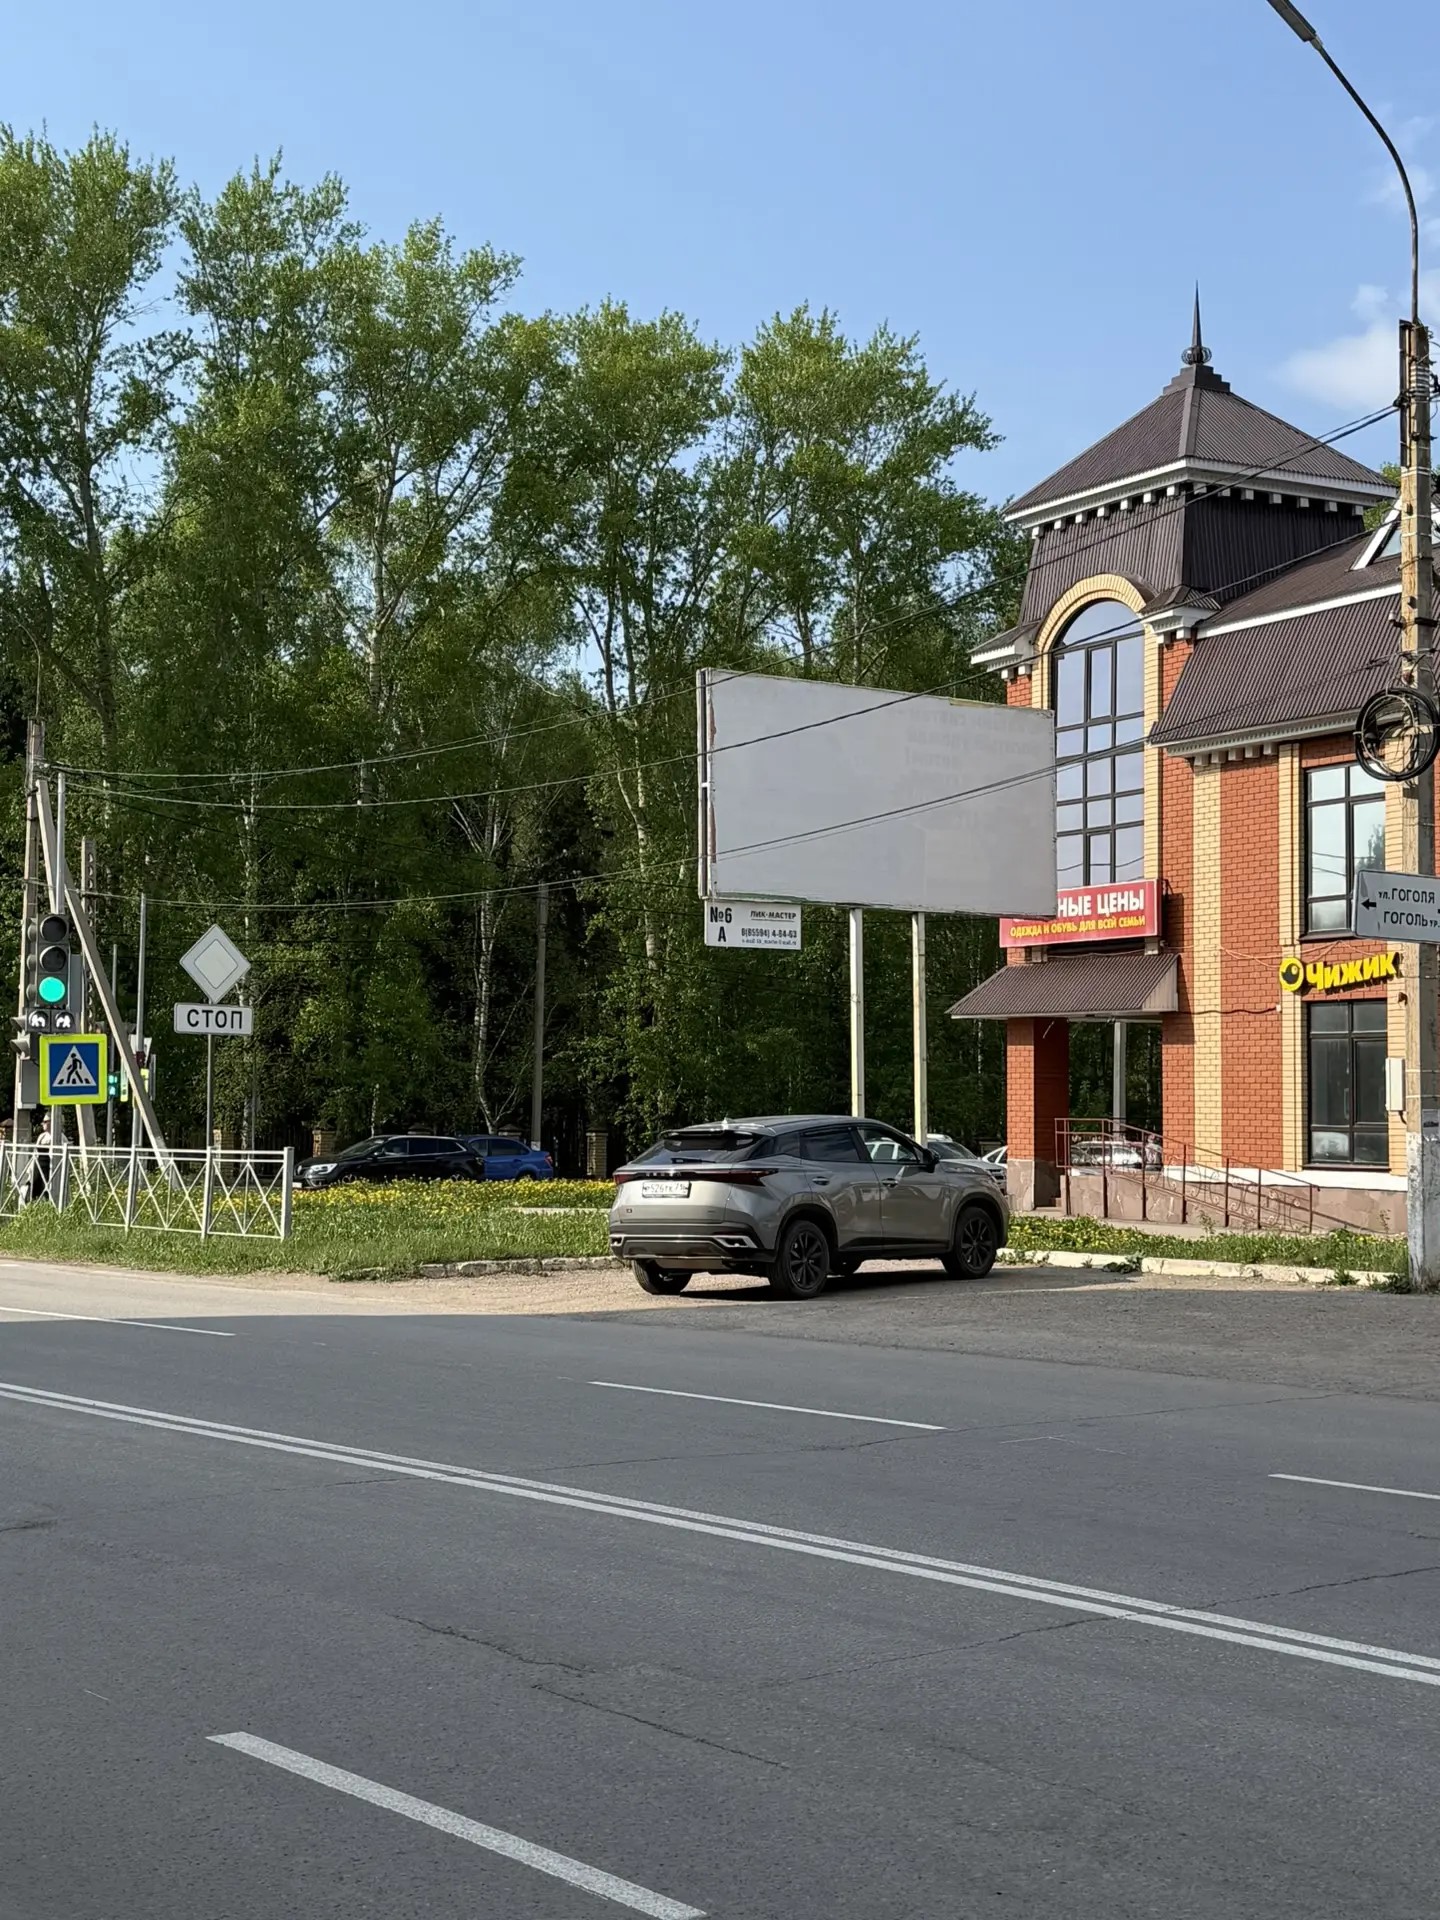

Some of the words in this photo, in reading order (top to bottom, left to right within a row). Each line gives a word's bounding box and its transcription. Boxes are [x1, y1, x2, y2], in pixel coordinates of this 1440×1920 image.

[1097, 889, 1144, 917] ЦЕНЫ
[1391, 888, 1435, 904] ГОГОЛЯ
[1010, 926, 1042, 938] ОДЕЖДА
[1043, 925, 1050, 934] И
[1051, 920, 1078, 934] ОБУВЬ
[1079, 919, 1096, 933] ДЛЯ
[1097, 917, 1117, 930] ВСЕЙ
[1118, 915, 1146, 929] СЕМЬИ
[1384, 911, 1428, 927] ГОГОЛЬ
[718, 926, 727, 942] А
[187, 1009, 242, 1029] СТОП
